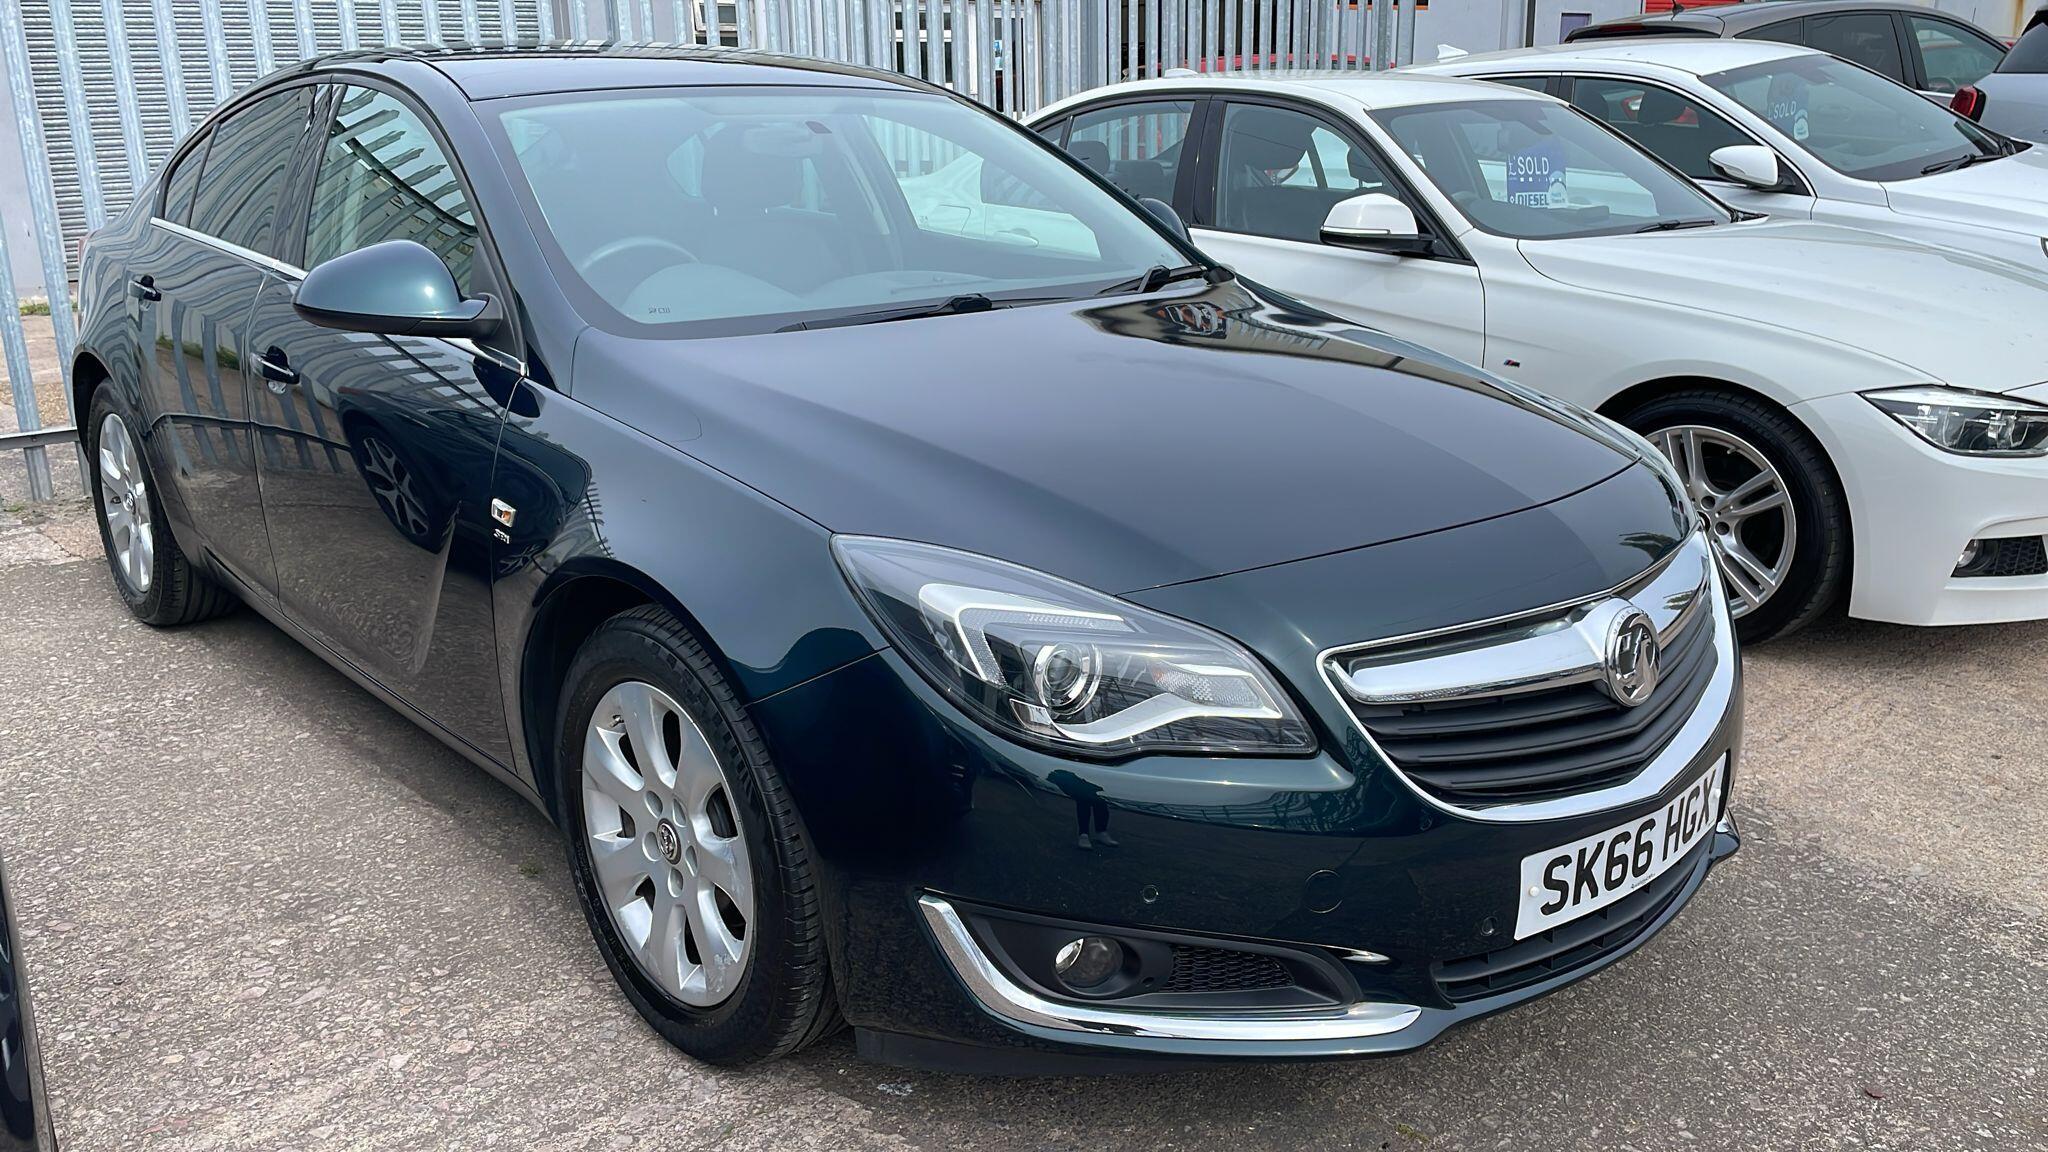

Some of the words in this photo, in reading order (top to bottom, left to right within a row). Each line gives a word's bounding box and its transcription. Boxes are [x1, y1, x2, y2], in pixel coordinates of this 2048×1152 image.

[1773, 100, 1797, 119] SOLD
[1517, 156, 1550, 175] SOLD
[1517, 193, 1549, 206] DIESEL
[1540, 818, 1656, 916] SK66
[1662, 769, 1716, 861] HGX
